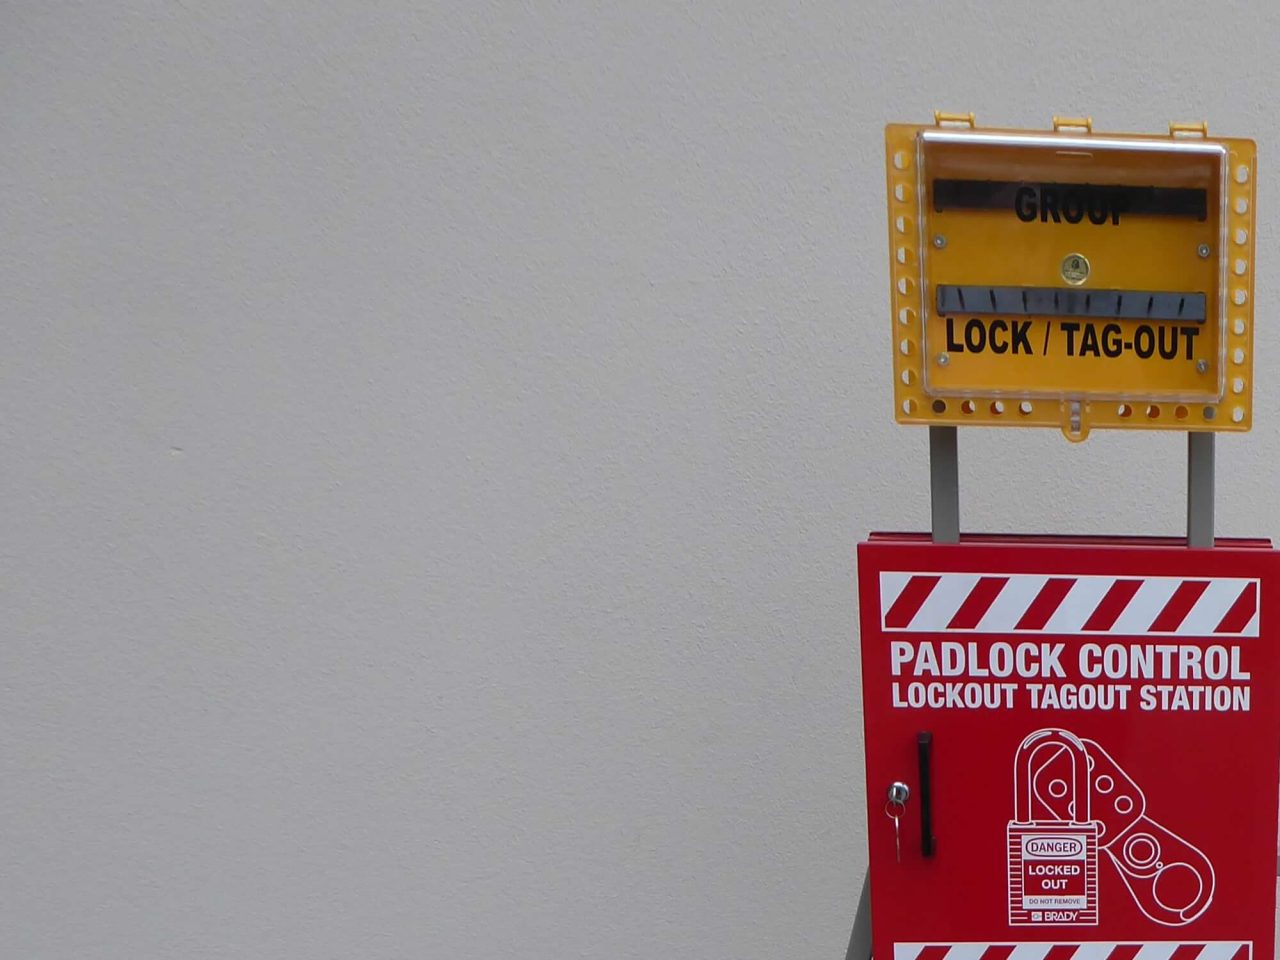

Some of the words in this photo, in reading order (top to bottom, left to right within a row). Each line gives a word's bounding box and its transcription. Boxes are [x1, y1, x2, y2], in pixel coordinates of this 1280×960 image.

[945, 318, 1034, 354] LOCK
[1061, 322, 1200, 360] TAG-OUT
[891, 641, 1067, 678] PADLOCK
[1078, 643, 1251, 681] CONTROL
[892, 682, 1018, 709] LOCKOUT
[1026, 684, 1131, 711] TAGOUT
[1140, 684, 1250, 712] STATION
[1030, 842, 1077, 853] DANGER
[1028, 865, 1081, 876] LOCKED
[1041, 879, 1069, 890] OUT
[1044, 911, 1079, 922] BRADY
